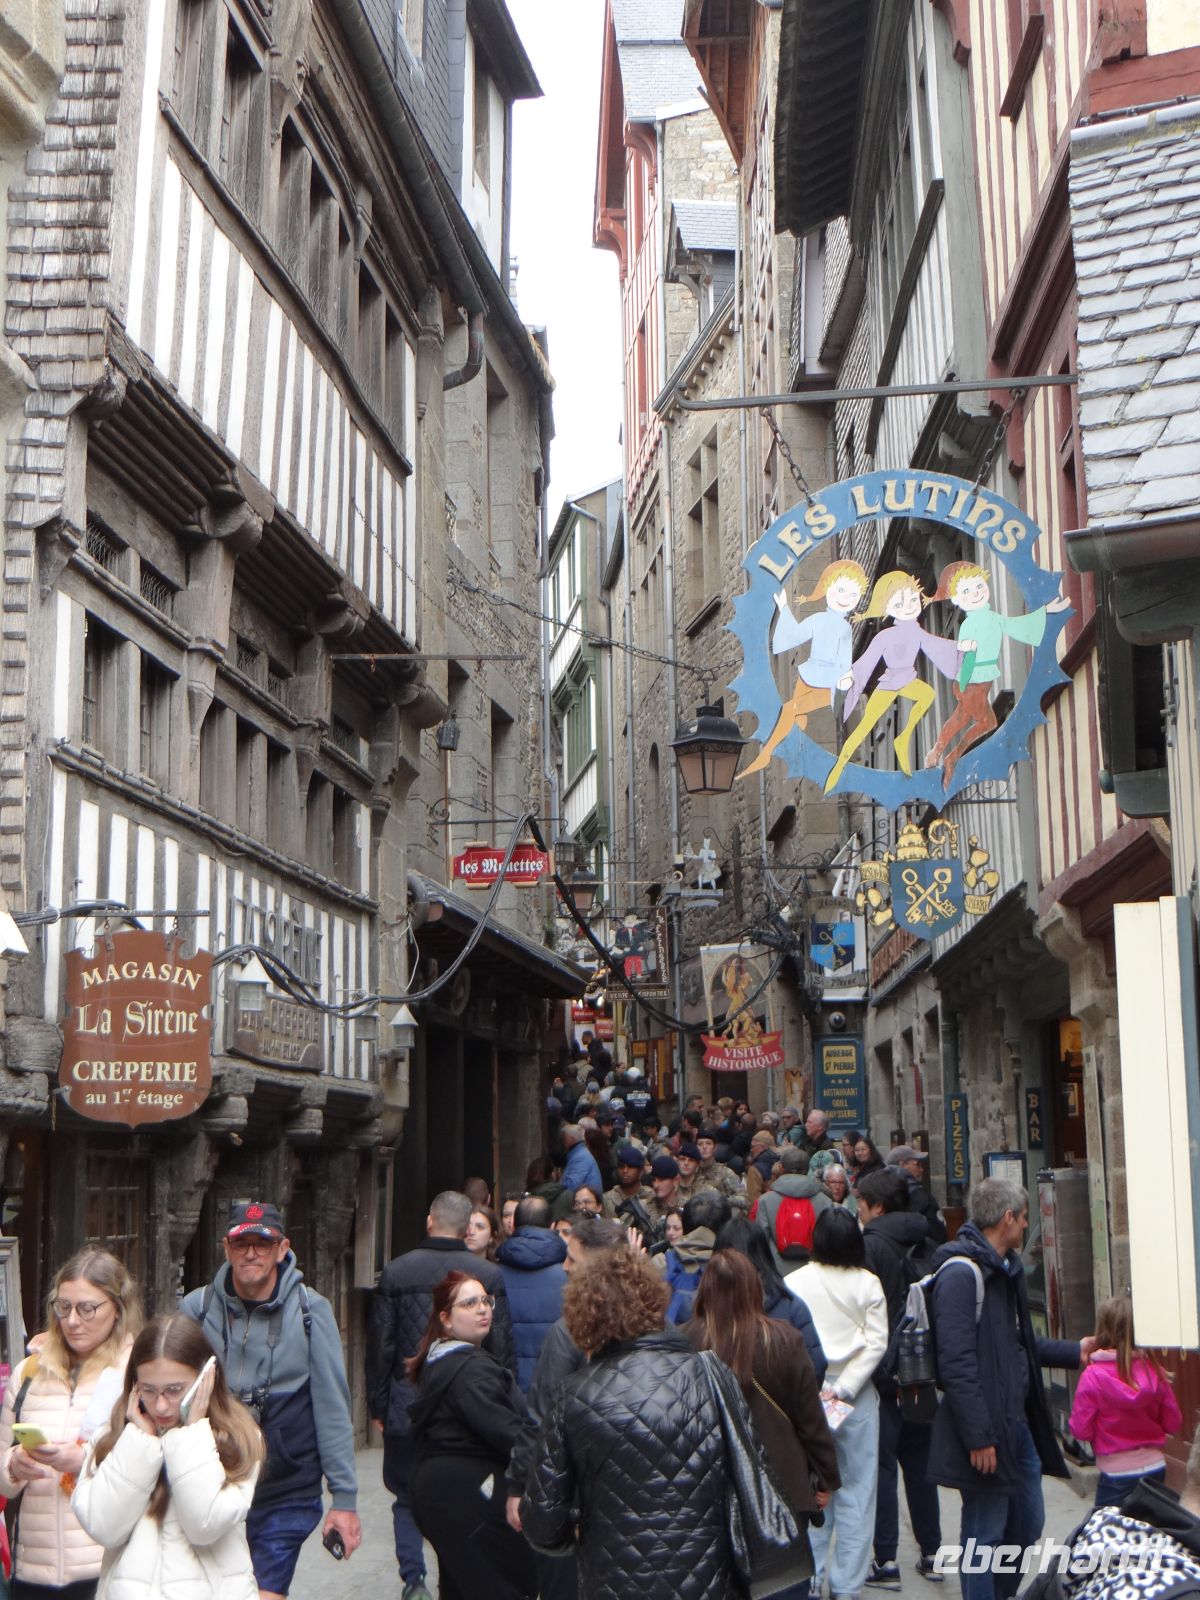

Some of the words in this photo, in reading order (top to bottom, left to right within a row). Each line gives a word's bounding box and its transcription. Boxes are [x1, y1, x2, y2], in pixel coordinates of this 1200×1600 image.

[759, 502, 836, 582] LES
[851, 479, 1027, 554] LUTINS
[460, 859, 479, 874] les
[80, 961, 203, 991] MAGASIN
[75, 1004, 112, 1036] La
[123, 1000, 199, 1042] Sirène
[708, 1050, 782, 1070] HISTORIQUE
[724, 1045, 764, 1058] VISITE
[73, 1059, 198, 1084] CREPERIE
[833, 1061, 855, 1071] PIERRE
[86, 1092, 107, 1106] au
[137, 1089, 184, 1110] étage
[823, 1087, 858, 1097] RESTAURANT
[832, 1098, 848, 1107] GRILL
[1027, 1093, 1041, 1142] BAR
[951, 1099, 964, 1178] PIZZAS
